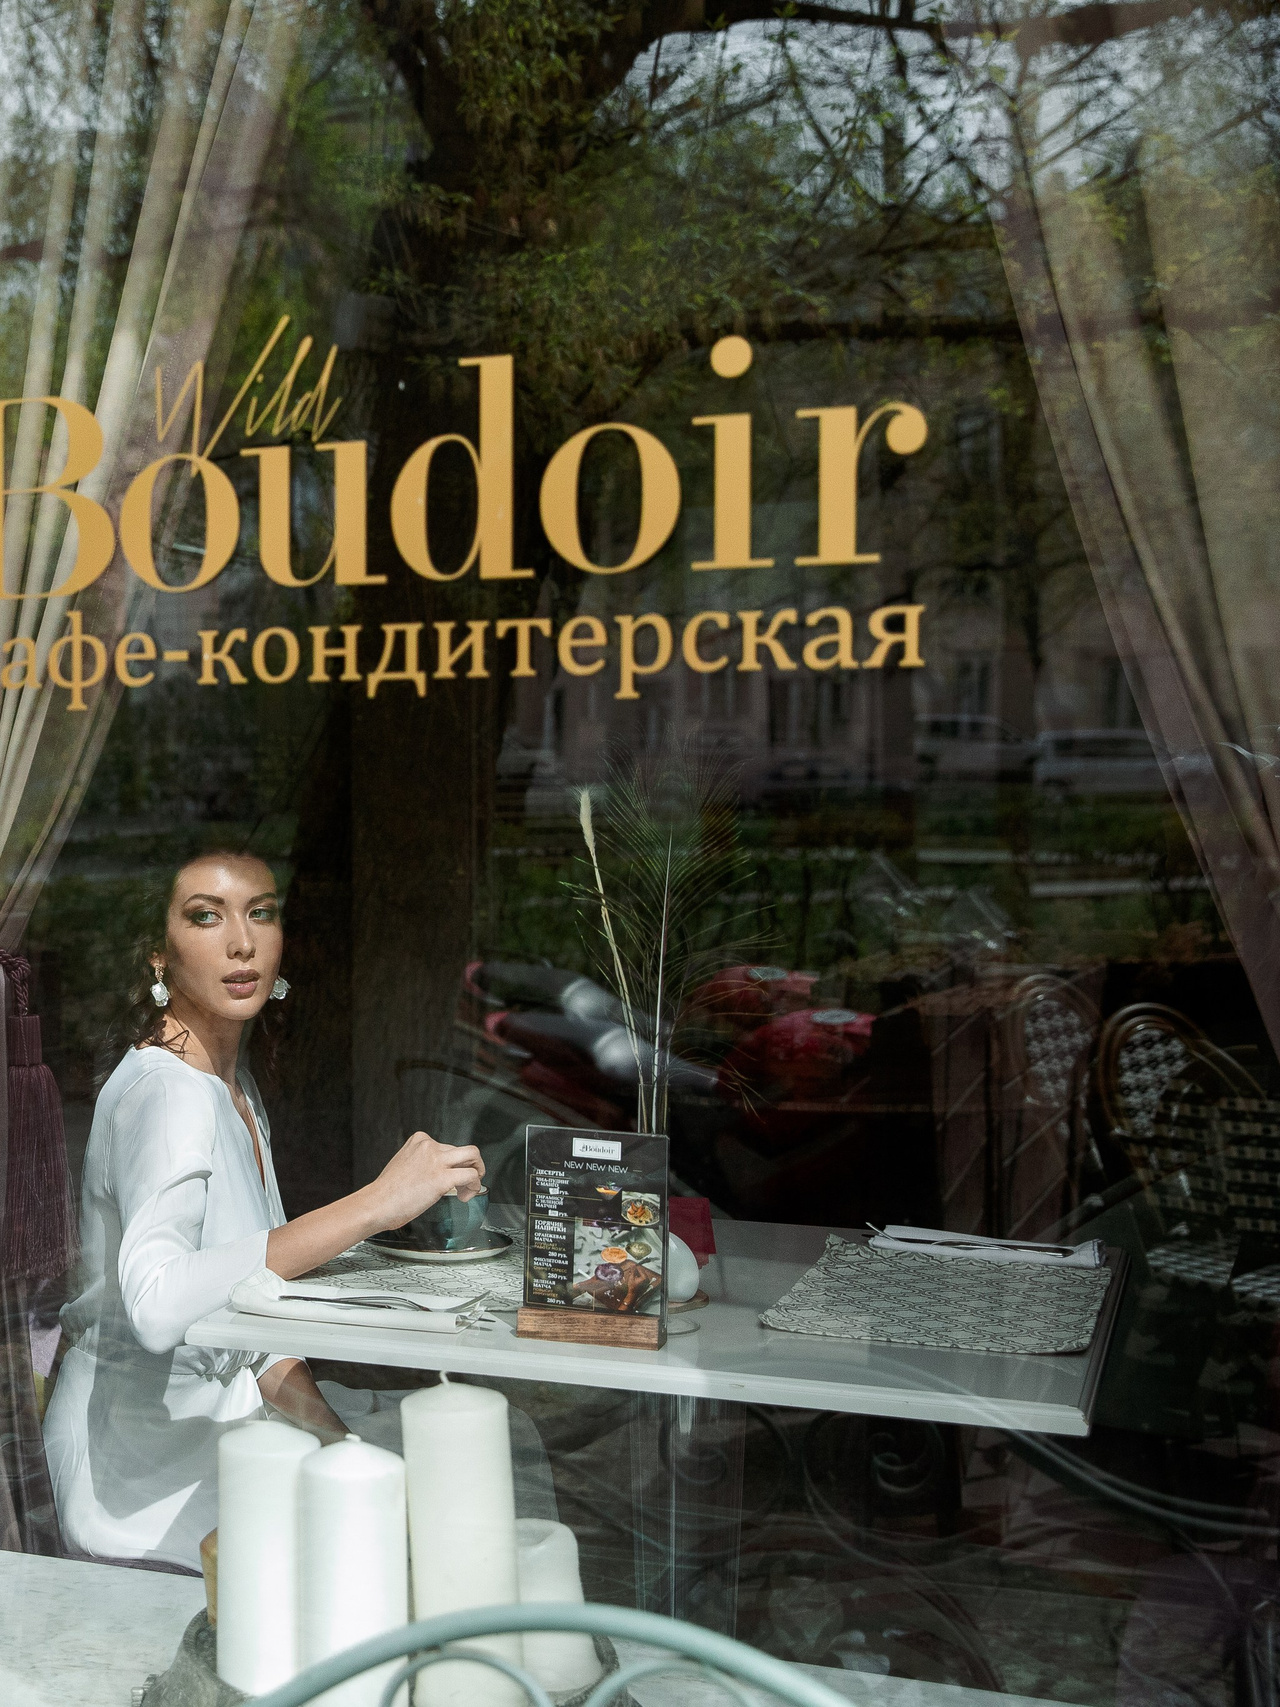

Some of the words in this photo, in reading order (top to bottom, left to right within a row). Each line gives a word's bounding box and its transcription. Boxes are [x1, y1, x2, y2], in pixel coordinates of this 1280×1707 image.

[154, 315, 341, 477] Wild
[564, 1160, 584, 1169] NEW
[586, 1162, 606, 1171] NEW
[608, 1164, 629, 1173] NEW
[536, 1169, 565, 1177] ДЕСЕРТЫ
[534, 1220, 563, 1228] ГОРЯЧИЕ
[534, 1225, 567, 1233] НАПИТКИ
[534, 1232, 566, 1240] ОРАНЖЕВАЯ
